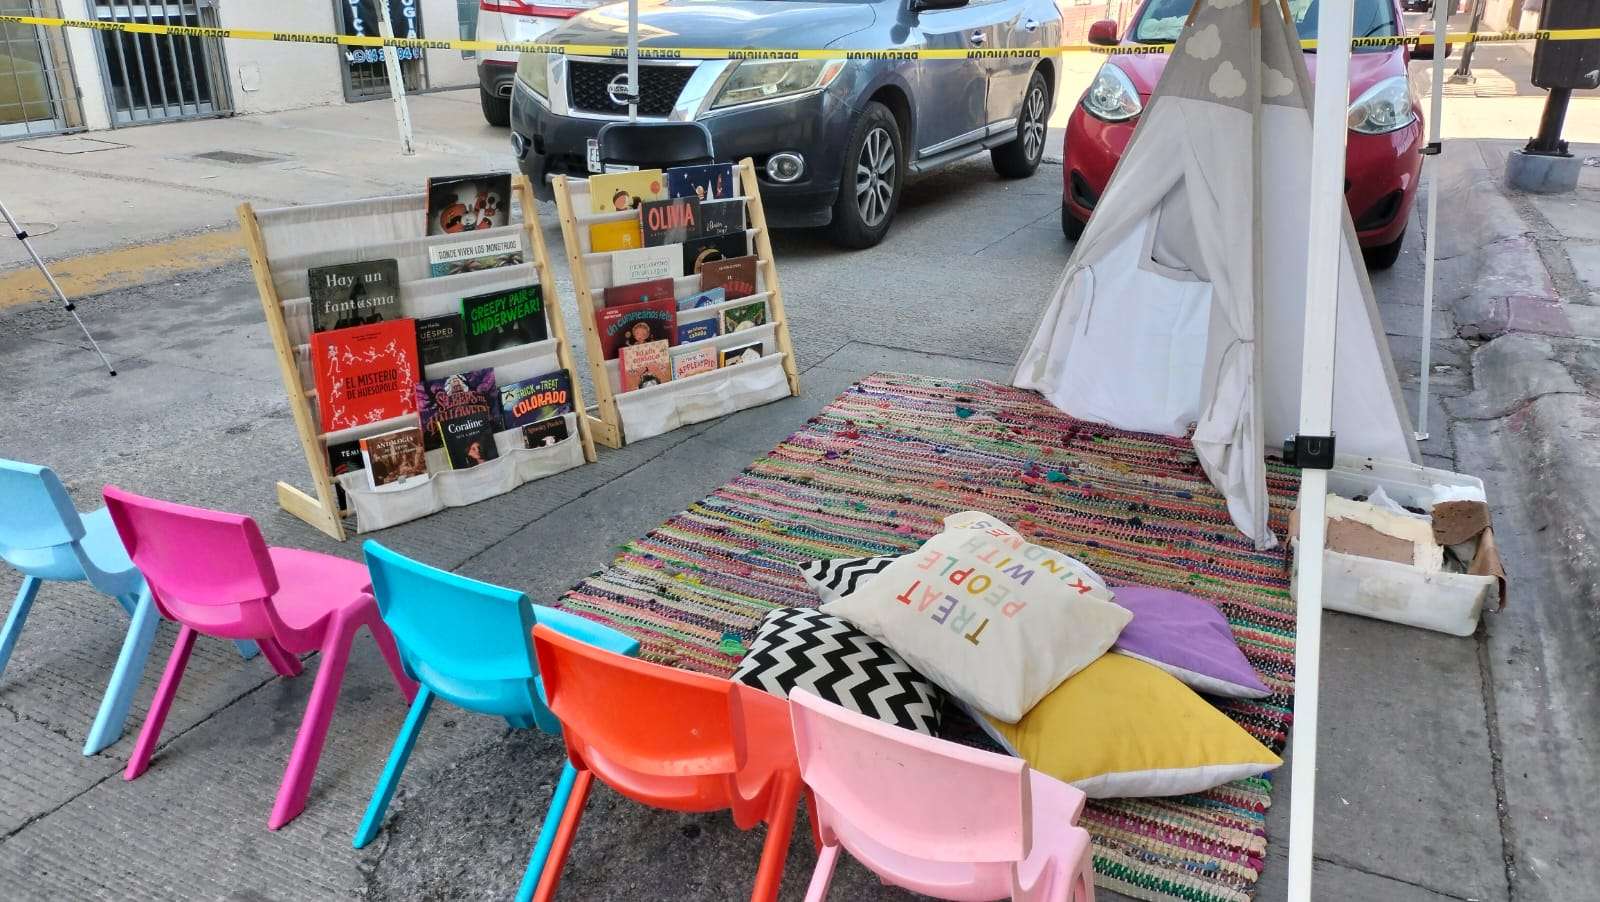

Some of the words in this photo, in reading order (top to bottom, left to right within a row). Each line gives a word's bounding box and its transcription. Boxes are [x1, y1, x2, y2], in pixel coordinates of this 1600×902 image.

[1352, 38, 1419, 47] PRECAUCIO
[611, 48, 681, 58] PRECAUION
[648, 203, 695, 231] OLIVIA
[438, 248, 456, 259] DONDE
[457, 246, 473, 257] VIVEN
[474, 245, 485, 254] LOS
[325, 273, 354, 287] Hay
[364, 272, 382, 283] un
[324, 295, 394, 313] fantasma
[471, 298, 506, 320] CREEPY
[509, 289, 528, 307] PAIR
[471, 298, 540, 336] UNDERWEAR!
[346, 377, 355, 389] EL
[357, 368, 398, 387] MISTERIO
[540, 378, 559, 392] TREAT
[347, 390, 357, 400] DE
[512, 390, 567, 418] COLORADO
[448, 420, 484, 433] Coraline
[959, 537, 1036, 586] WITH
[917, 550, 1027, 621] PEOPLE
[896, 579, 990, 646] TREAT
